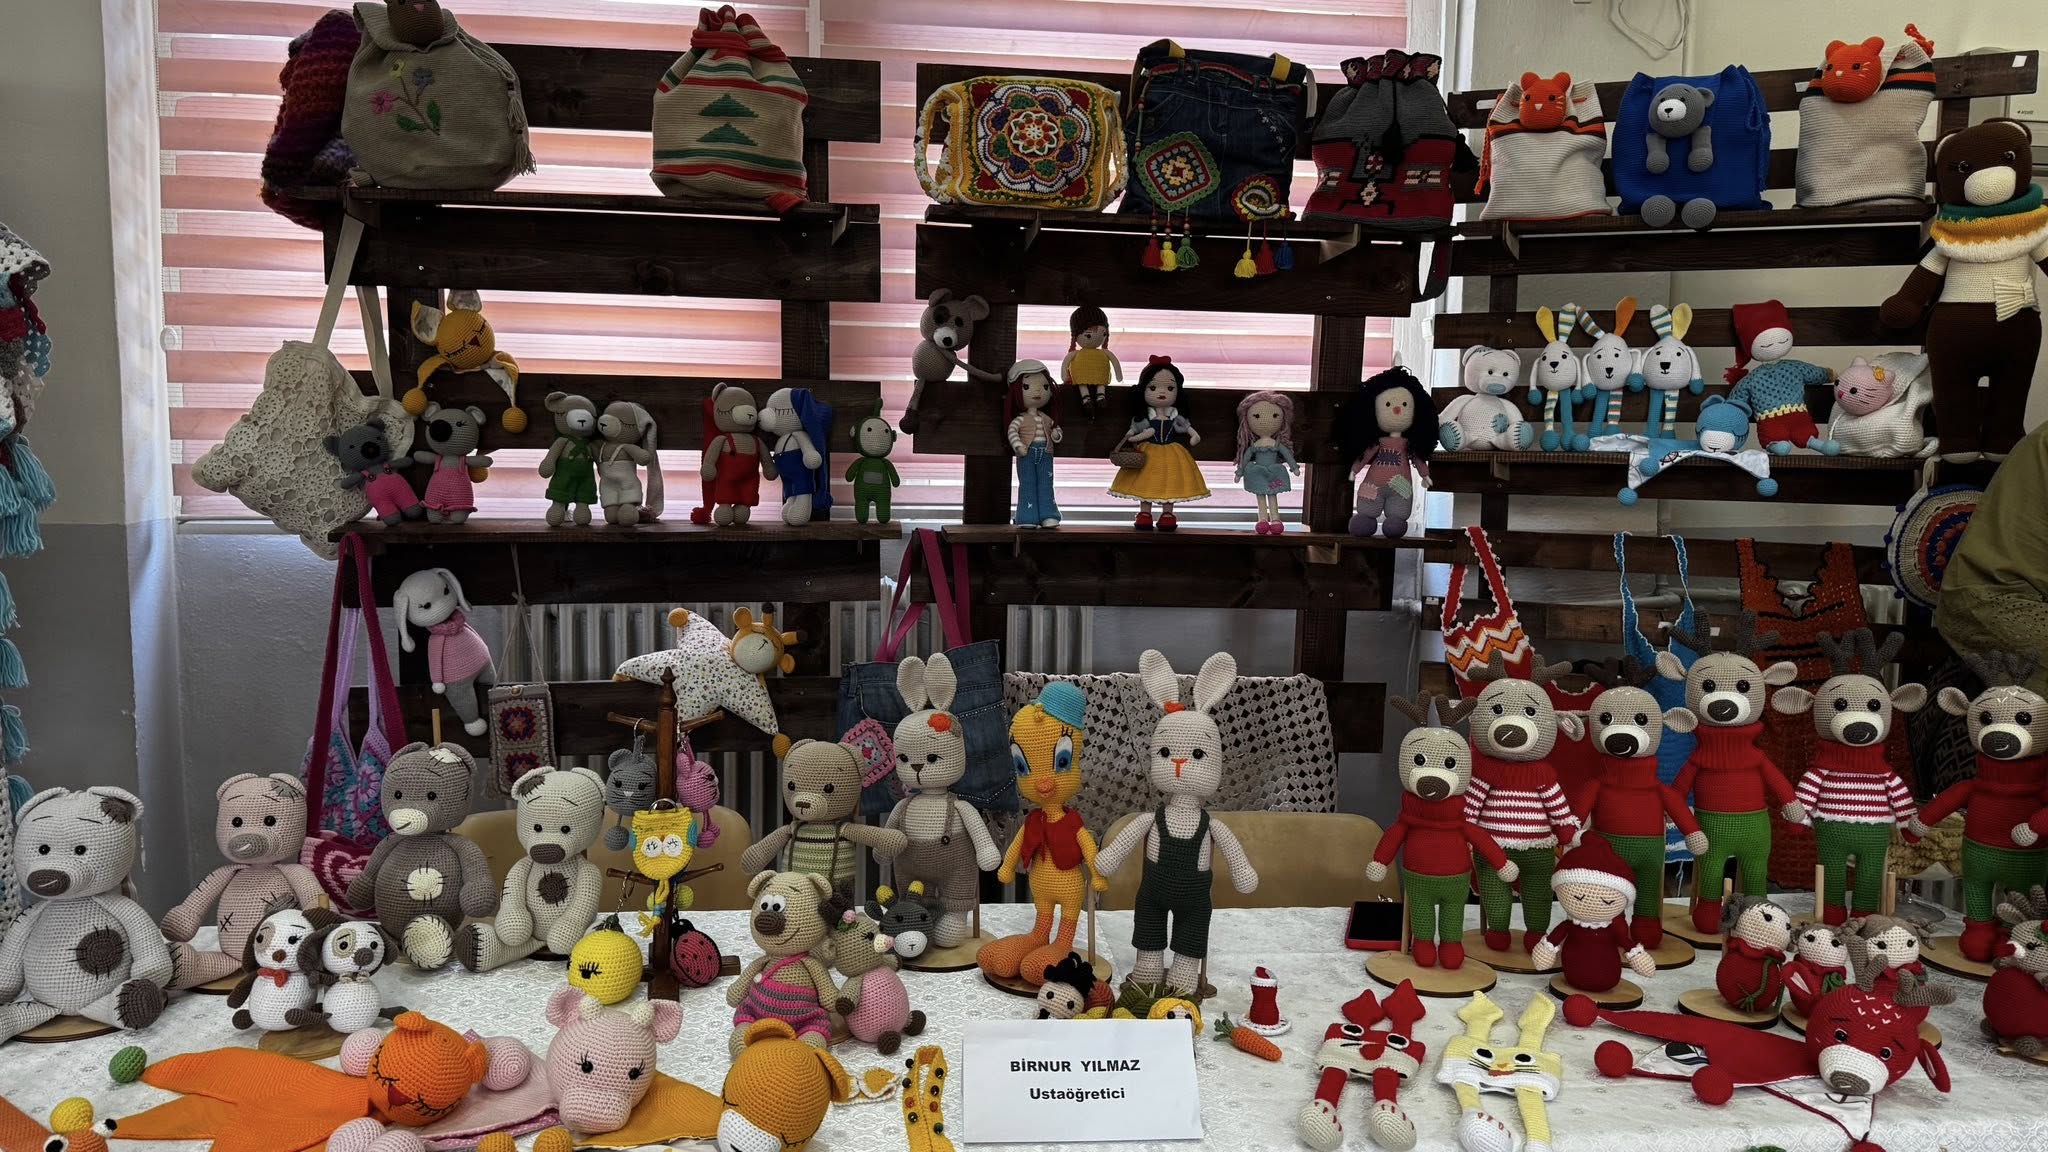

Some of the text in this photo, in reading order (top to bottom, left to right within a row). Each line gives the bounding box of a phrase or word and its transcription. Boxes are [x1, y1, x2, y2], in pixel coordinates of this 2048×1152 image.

[1010, 1057, 1141, 1073] BİRNUR YILMAZ
[1029, 1087, 1126, 1103] Ustaöğretici
